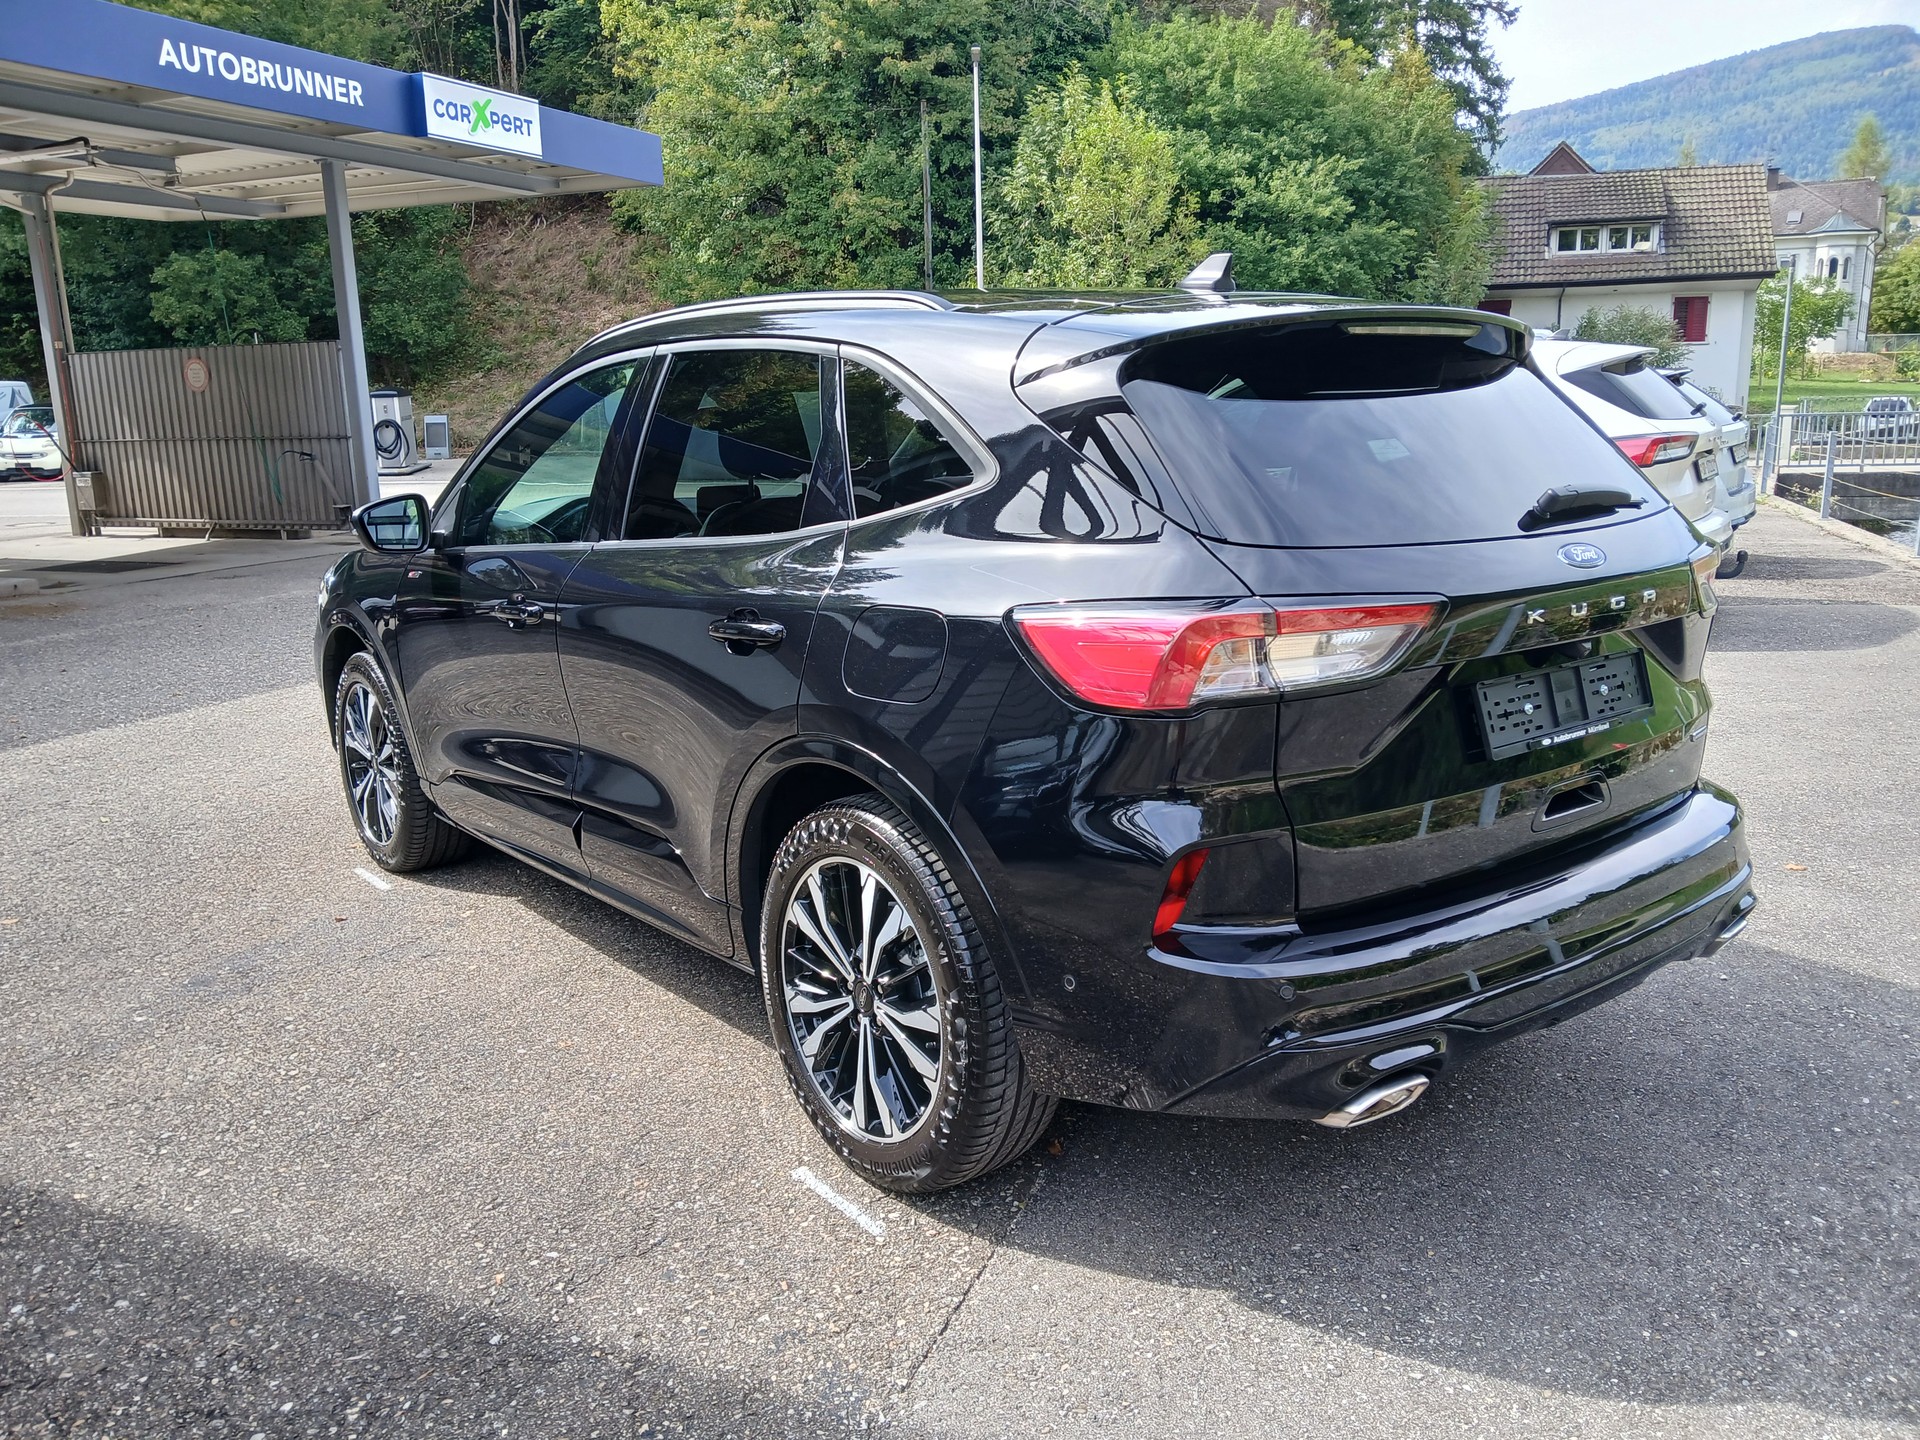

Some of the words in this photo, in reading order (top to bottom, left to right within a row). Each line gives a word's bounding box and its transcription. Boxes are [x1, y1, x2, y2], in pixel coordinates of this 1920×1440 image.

[158, 38, 365, 107] AUTOBRUNNER
[1571, 546, 1599, 561] Ford
[1527, 588, 1657, 624] KUGA
